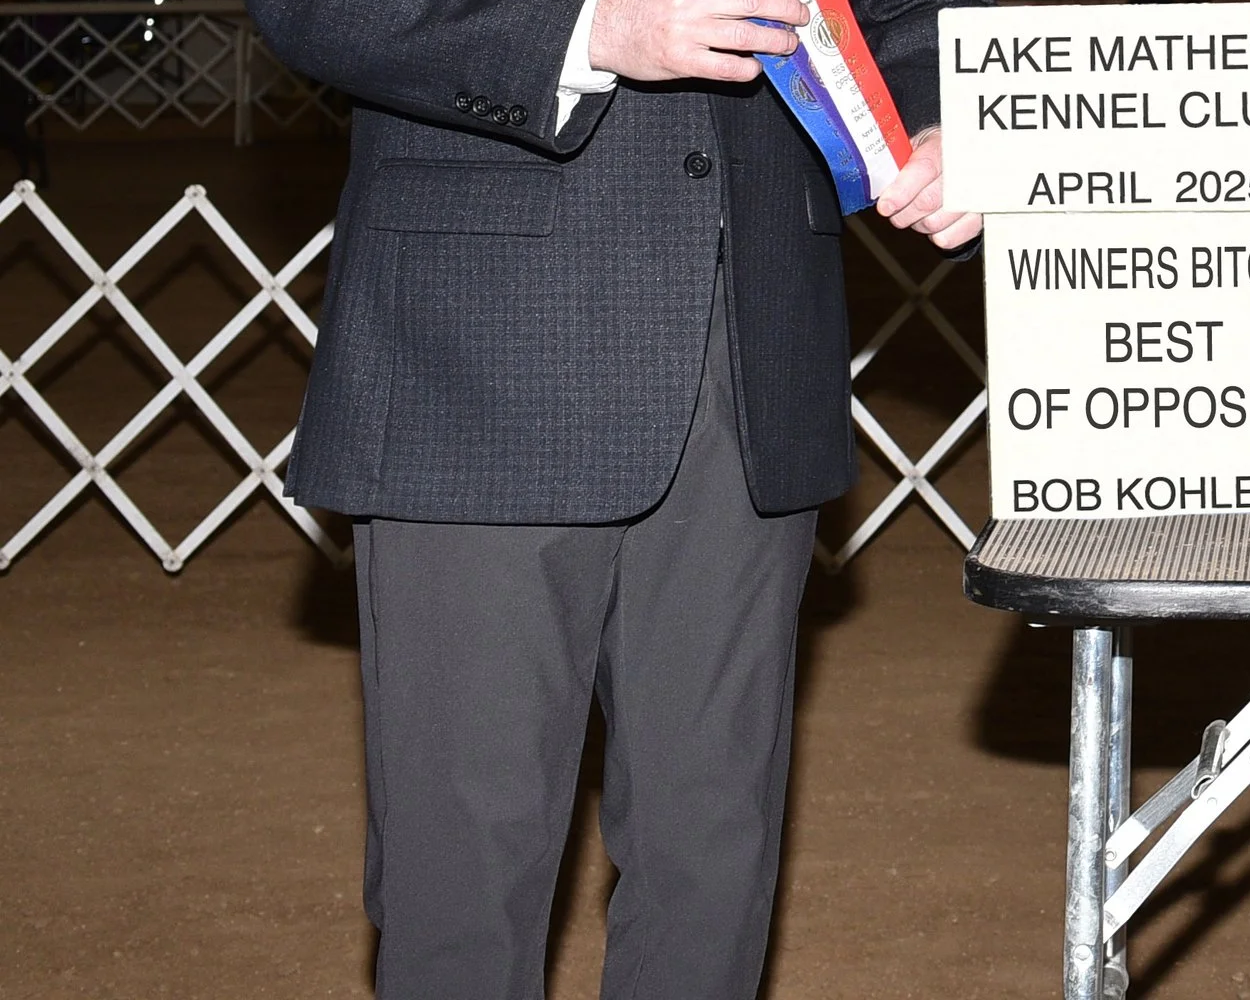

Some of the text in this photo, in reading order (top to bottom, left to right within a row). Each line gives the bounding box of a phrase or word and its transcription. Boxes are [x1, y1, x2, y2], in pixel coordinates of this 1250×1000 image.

[955, 37, 1071, 73] LAKE
[979, 93, 1165, 130] KENNEL
[1028, 172, 1151, 205] APRIL
[1008, 247, 1178, 290] WINNERS
[1106, 321, 1223, 362] BEST
[1009, 388, 1070, 430] OF
[1014, 479, 1101, 512] BOB
